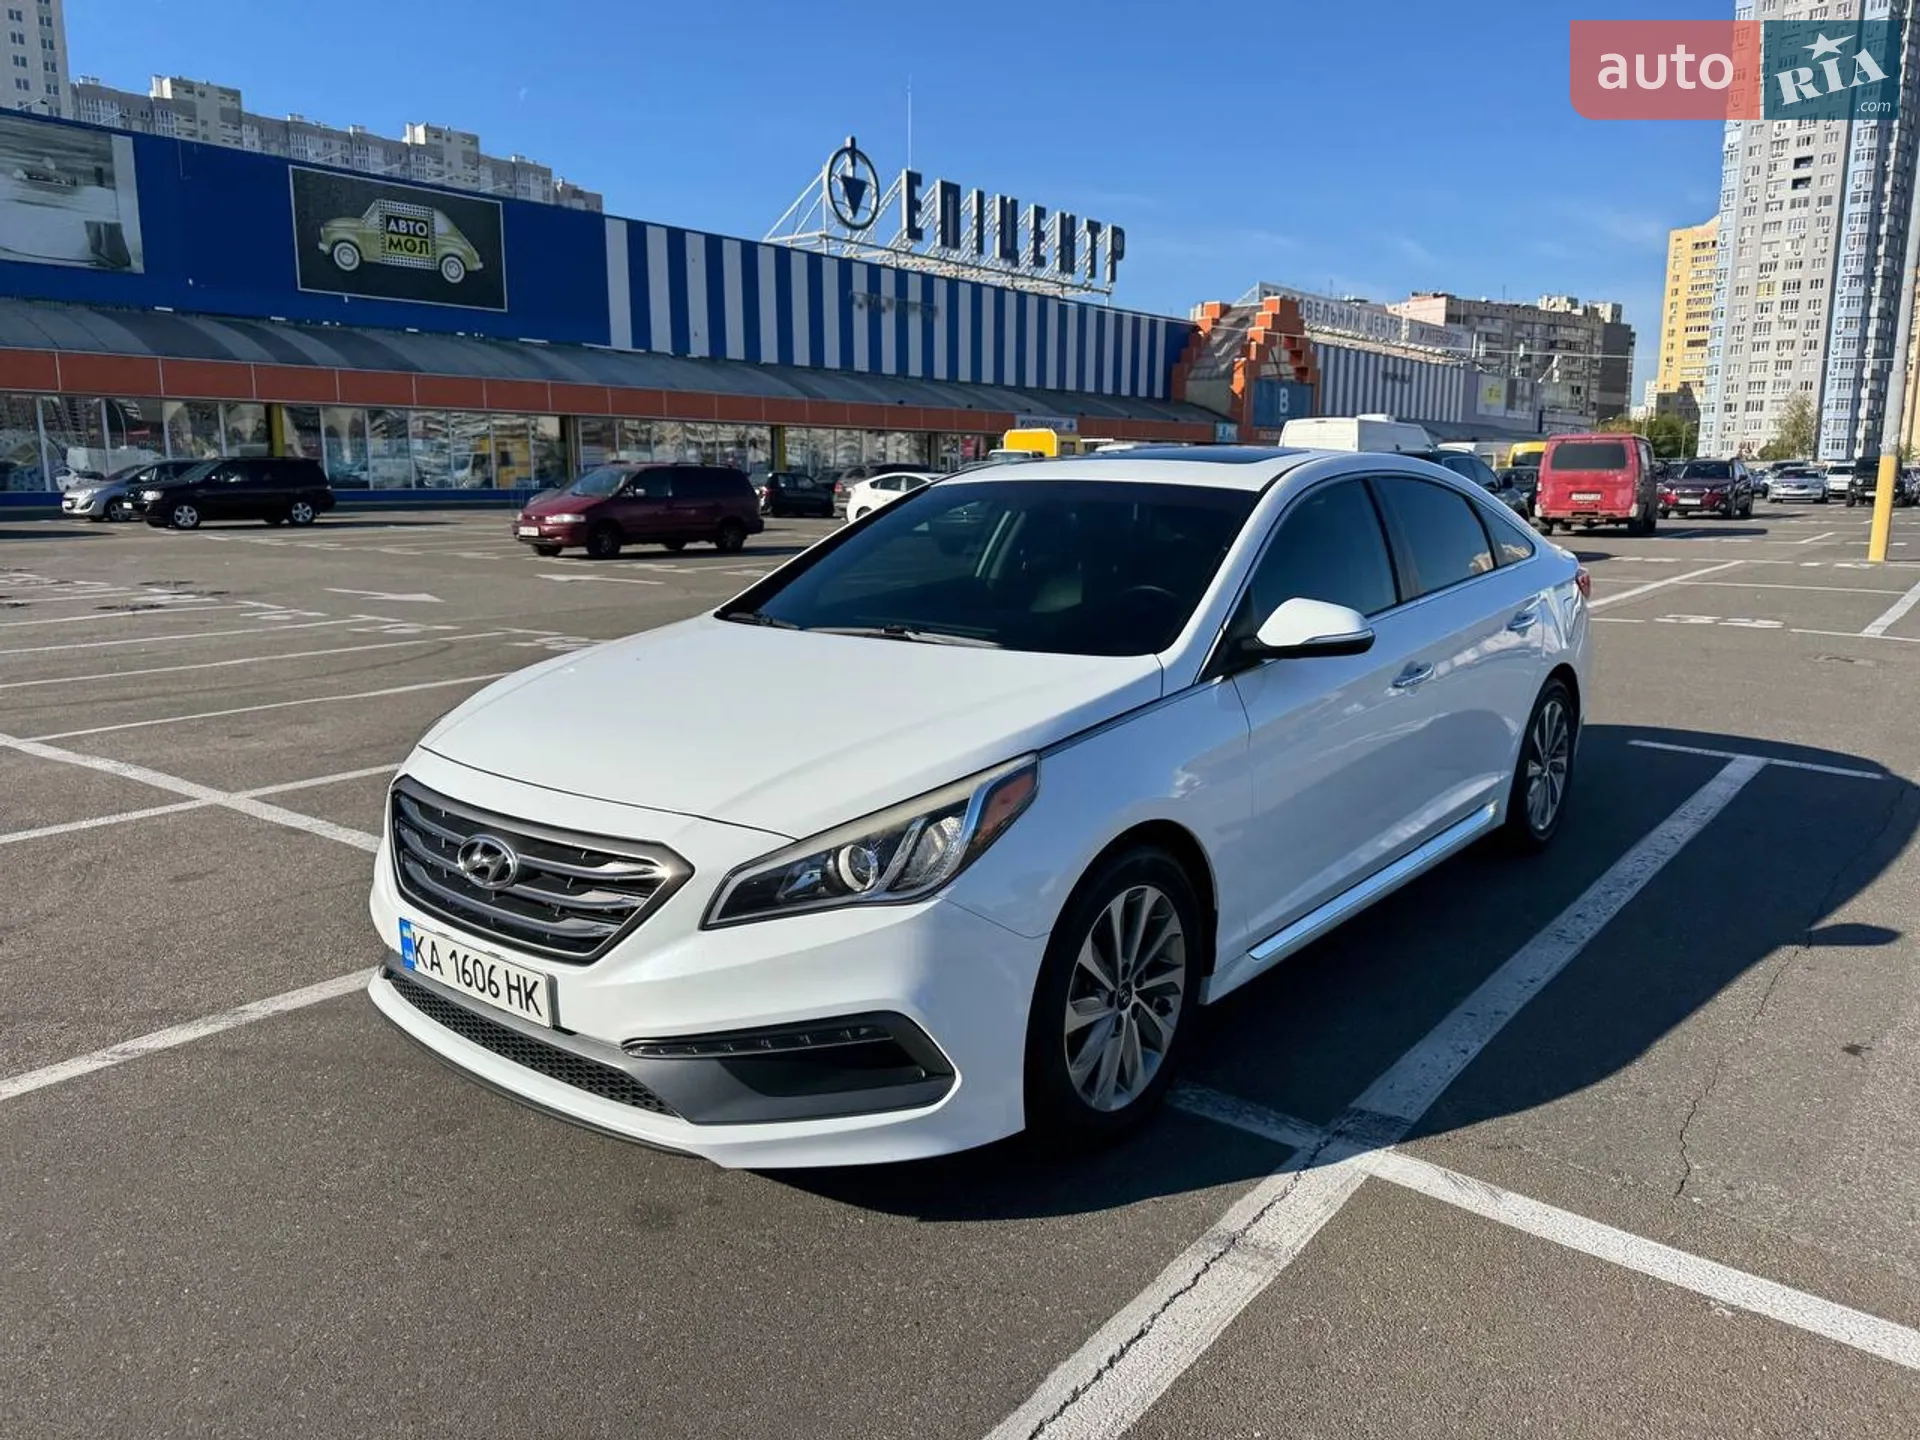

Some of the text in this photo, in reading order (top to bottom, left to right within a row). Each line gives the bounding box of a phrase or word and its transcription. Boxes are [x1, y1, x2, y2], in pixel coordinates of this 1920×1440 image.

[387, 217, 428, 236] АВТО
[387, 237, 430, 255] МОЛ
[901, 169, 1126, 284] ЕПІЦЕНТР
[412, 931, 543, 1018] KA 1606 HK
